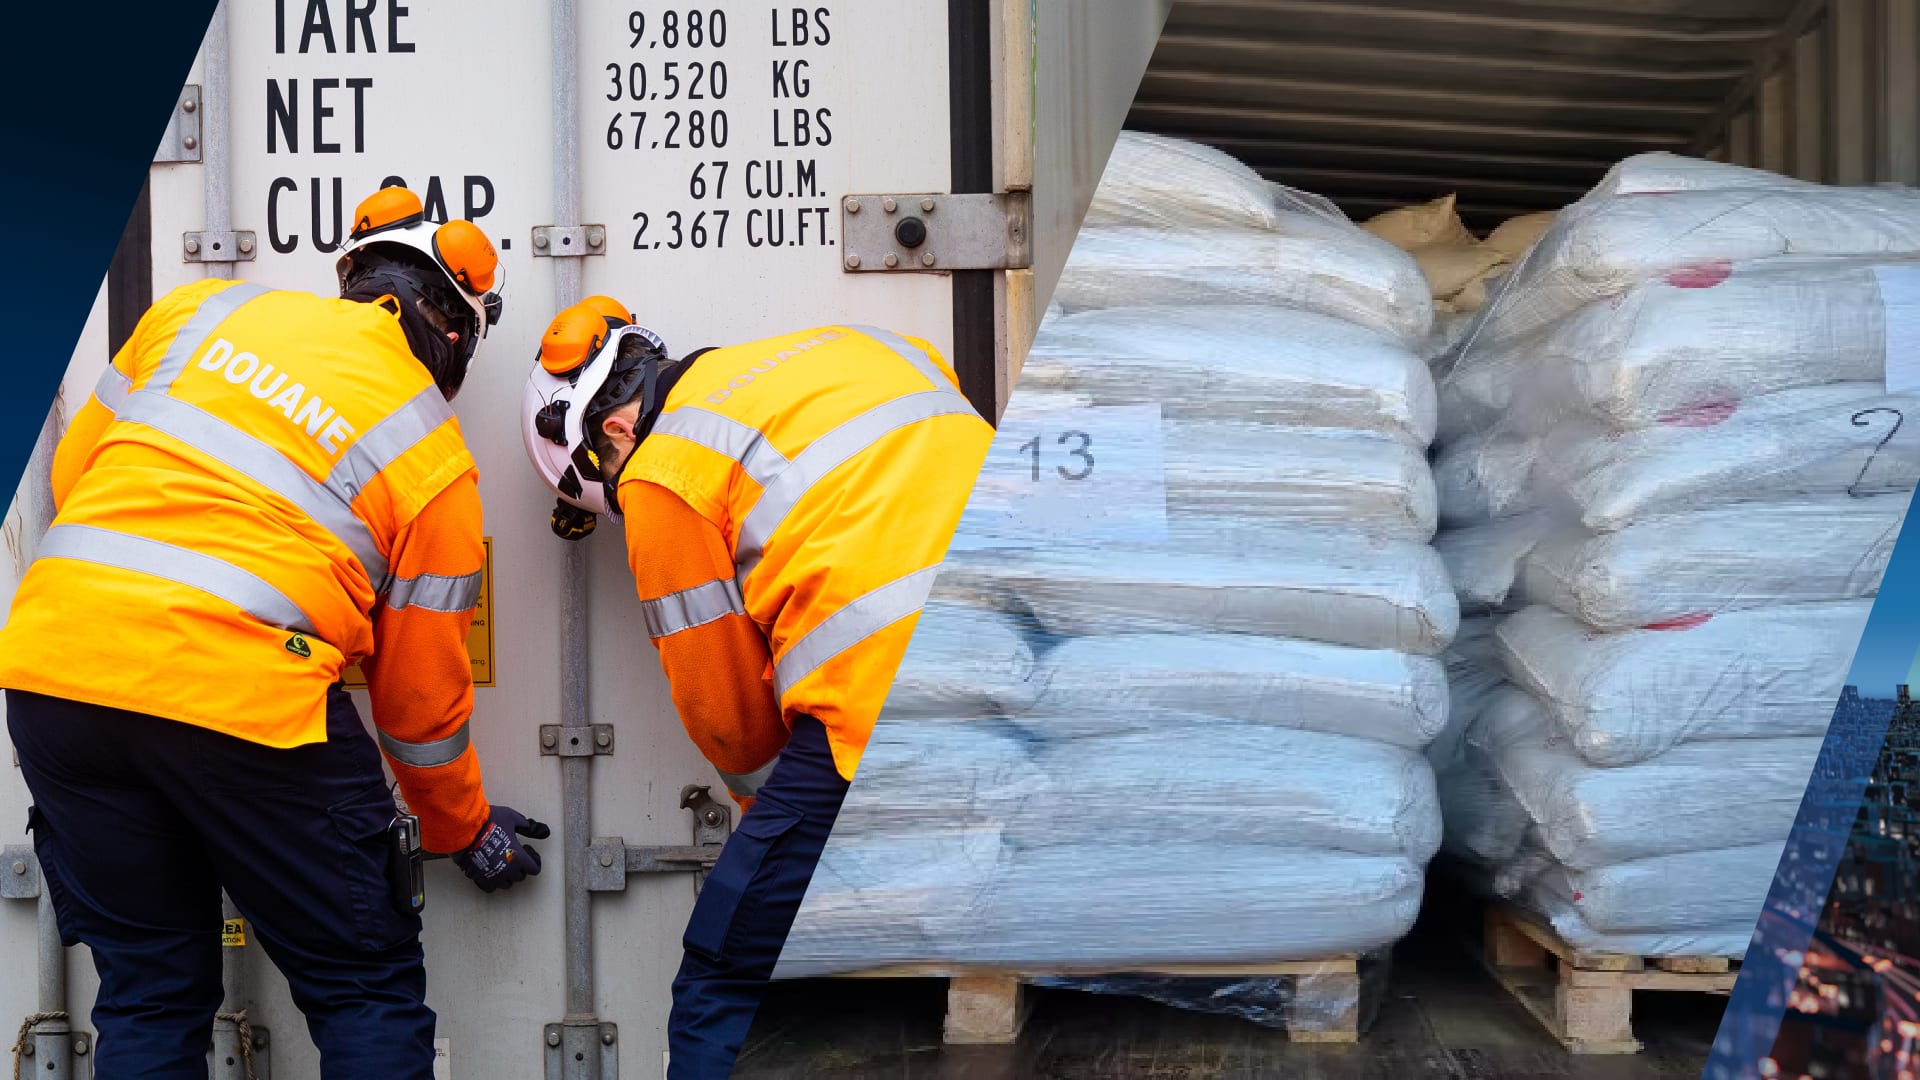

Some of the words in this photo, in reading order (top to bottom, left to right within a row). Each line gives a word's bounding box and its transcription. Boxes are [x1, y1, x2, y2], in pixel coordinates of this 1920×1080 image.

[276, 0, 416, 54] TARE
[628, 9, 727, 49] 9,880
[771, 7, 831, 47] LBS
[605, 60, 728, 102] 30,520
[772, 59, 810, 98] KG
[266, 78, 374, 154] NET
[606, 109, 728, 151] 67,280
[773, 107, 832, 147] LBS
[690, 161, 729, 200] 67
[745, 159, 827, 199] CU.M.
[379, 175, 511, 250] AP.
[632, 209, 730, 250] 2,367
[746, 207, 835, 248] CU.FT.
[704, 329, 849, 405] DOUANE
[197, 337, 356, 456] DOUANE
[1019, 429, 1095, 483] 13
